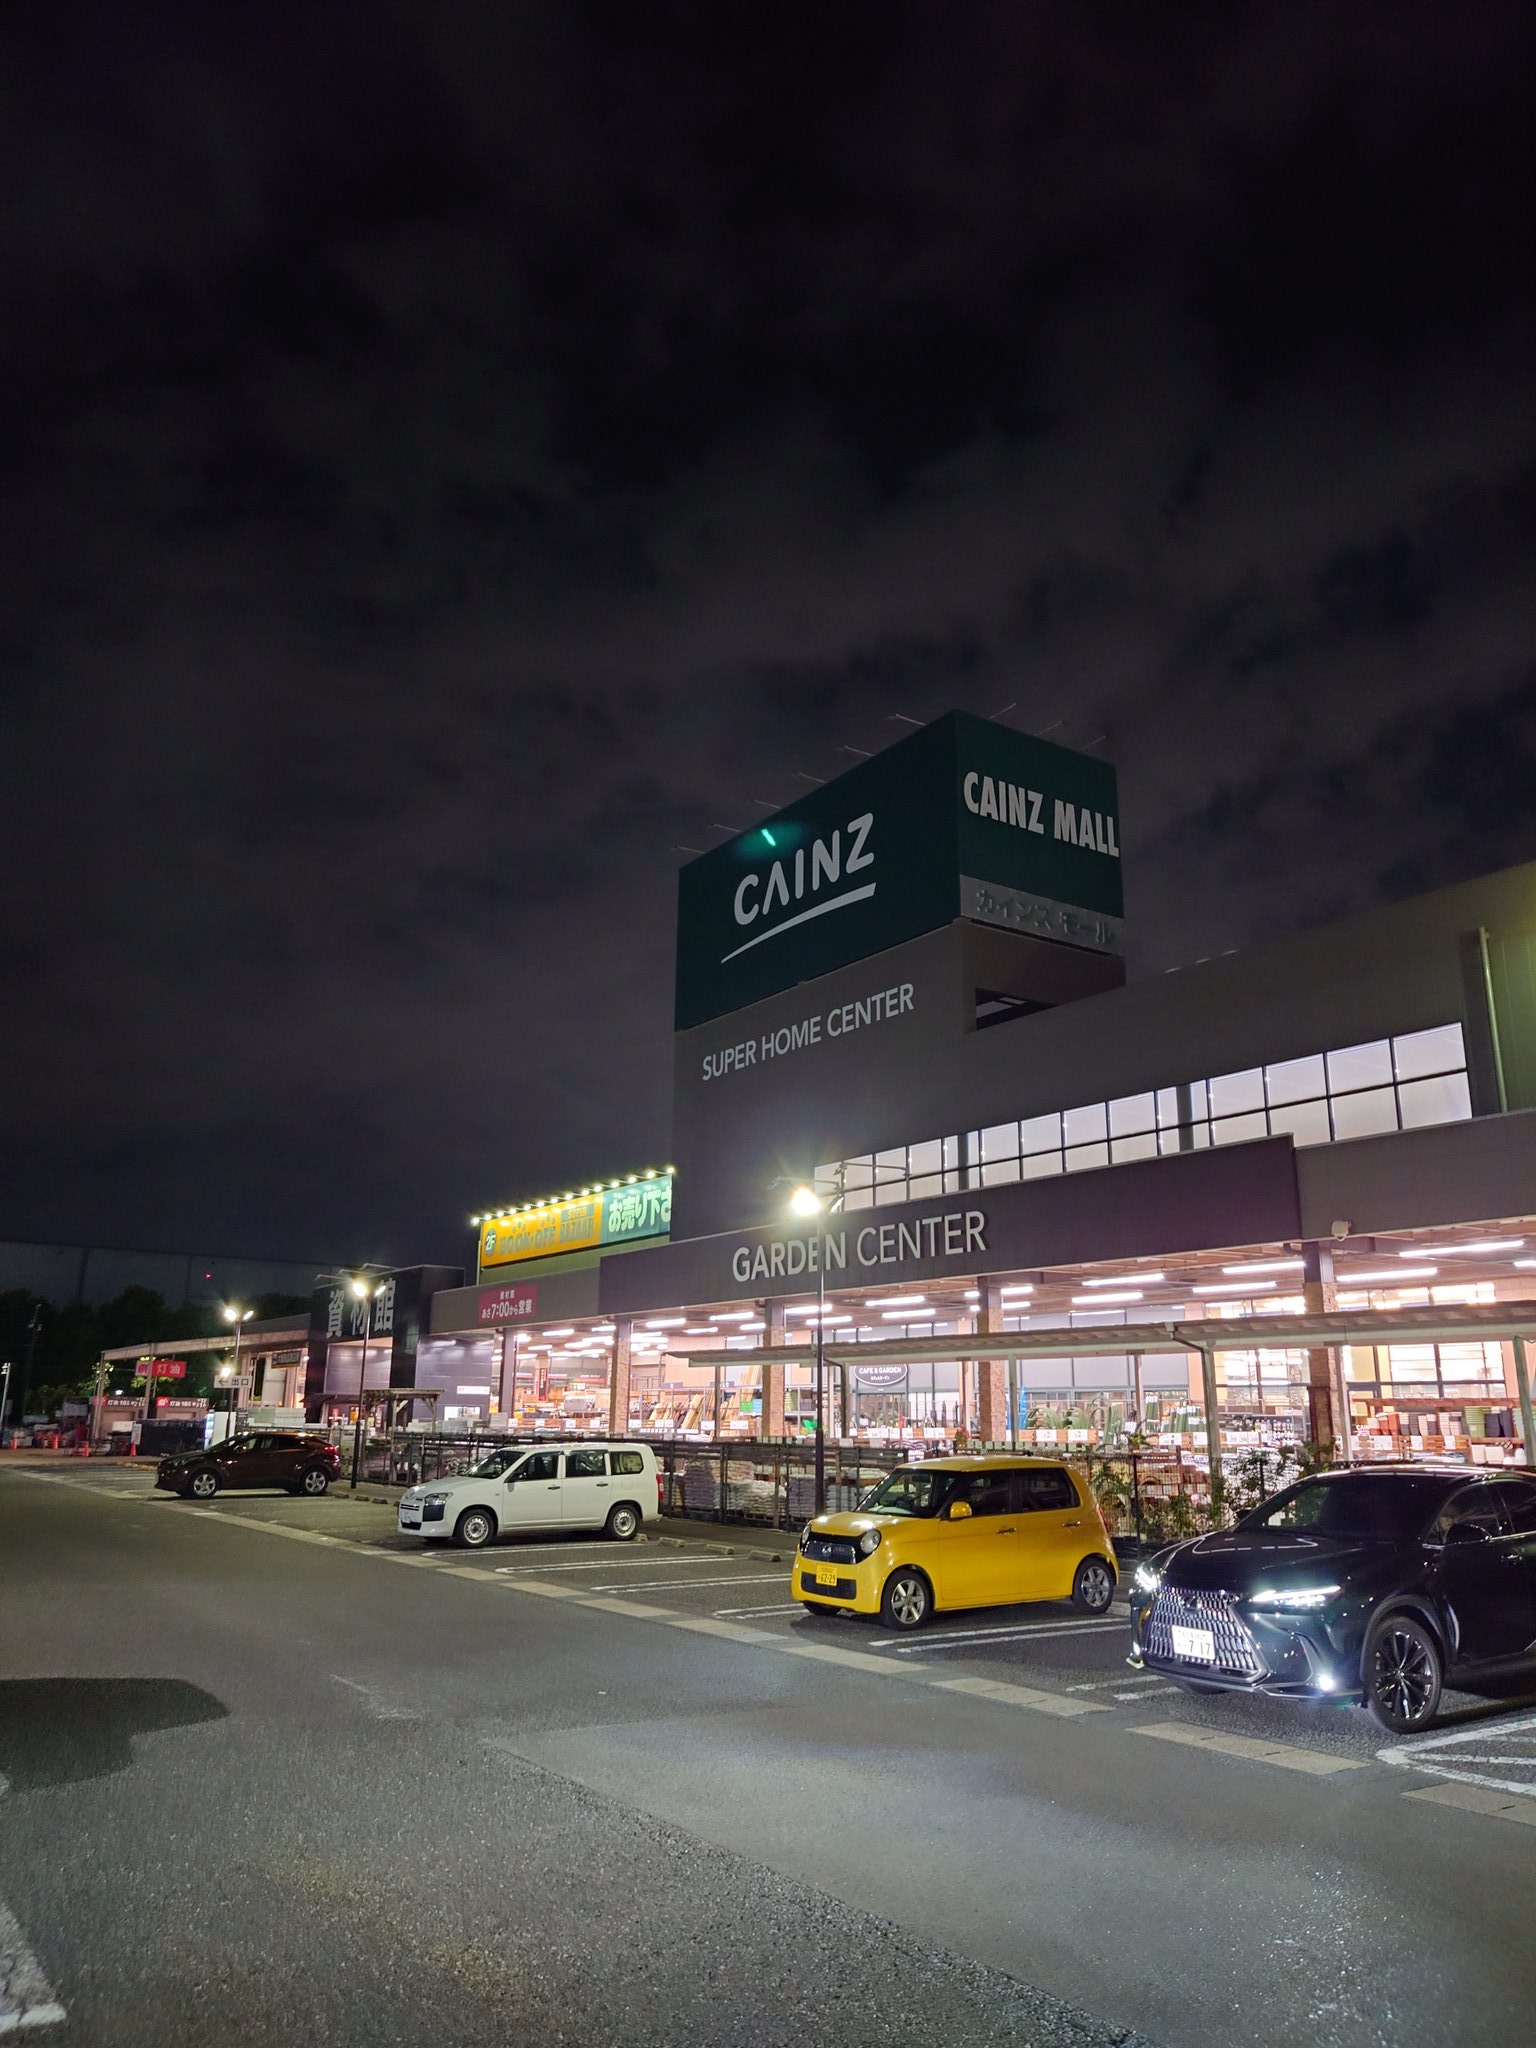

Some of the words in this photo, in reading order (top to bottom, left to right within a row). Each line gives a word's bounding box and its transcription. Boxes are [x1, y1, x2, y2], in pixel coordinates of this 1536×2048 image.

[963, 771, 1045, 835] CAINZ
[1053, 800, 1120, 859] MALL
[732, 812, 876, 926] CAINZ
[702, 1040, 757, 1081] SUPER
[761, 1015, 822, 1058] HOME
[827, 982, 914, 1037] CENTER
[485, 1234, 496, 1252] 2F
[732, 1230, 847, 1283] GARDEN
[856, 1210, 987, 1267] CENTER
[231, 1377, 249, 1387] 出口
